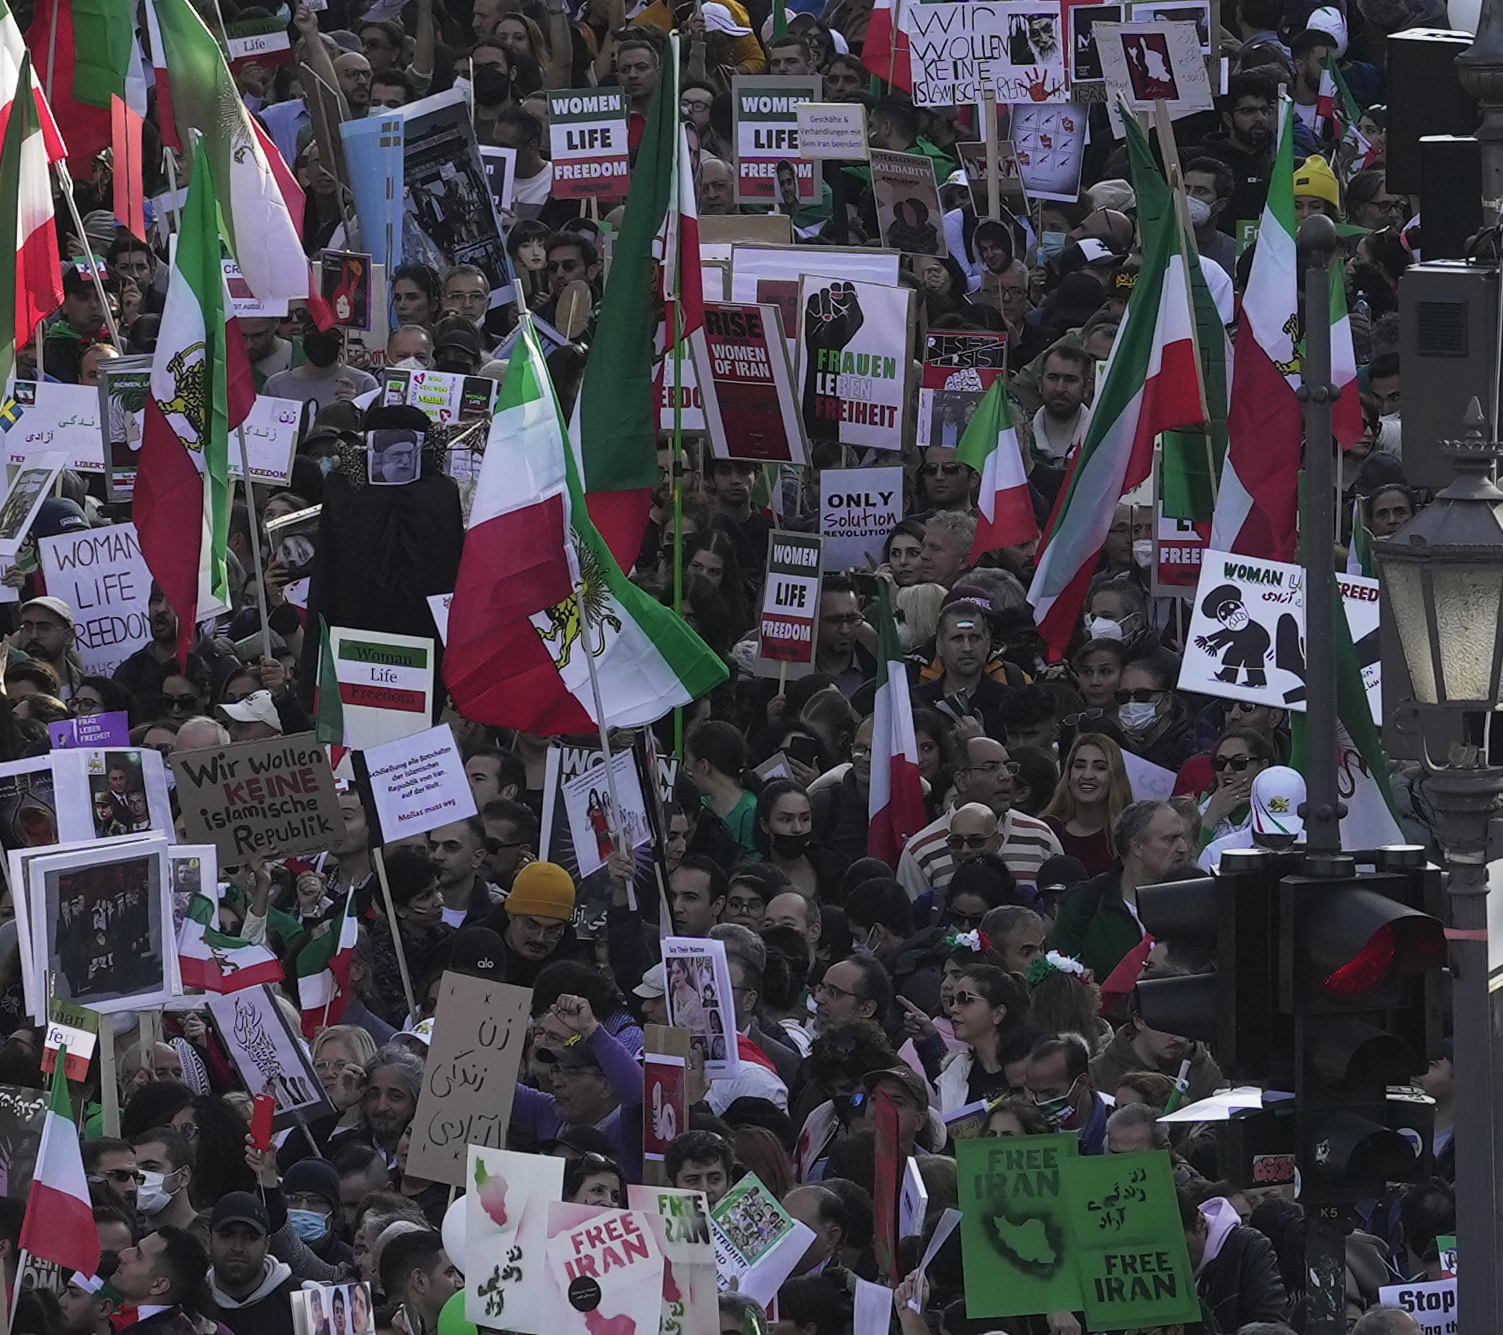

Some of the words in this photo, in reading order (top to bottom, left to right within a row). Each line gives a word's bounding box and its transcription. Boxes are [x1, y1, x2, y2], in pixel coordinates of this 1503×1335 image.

[707, 310, 762, 338] RISE
[710, 343, 765, 363] WOMEN
[715, 360, 732, 375] OF
[734, 362, 770, 378] IRAN
[817, 348, 896, 380] FRAUEN
[816, 370, 872, 402] LEBEN
[815, 394, 898, 429] FREIHEIT
[827, 491, 895, 509] ONLY
[823, 508, 897, 529] Solution
[222, 767, 320, 805] KEINE
[199, 796, 318, 832] islamische
[233, 813, 333, 856] Republik
[1103, 1250, 1174, 1276] FREE
[1093, 1272, 1177, 1305] IRAN
